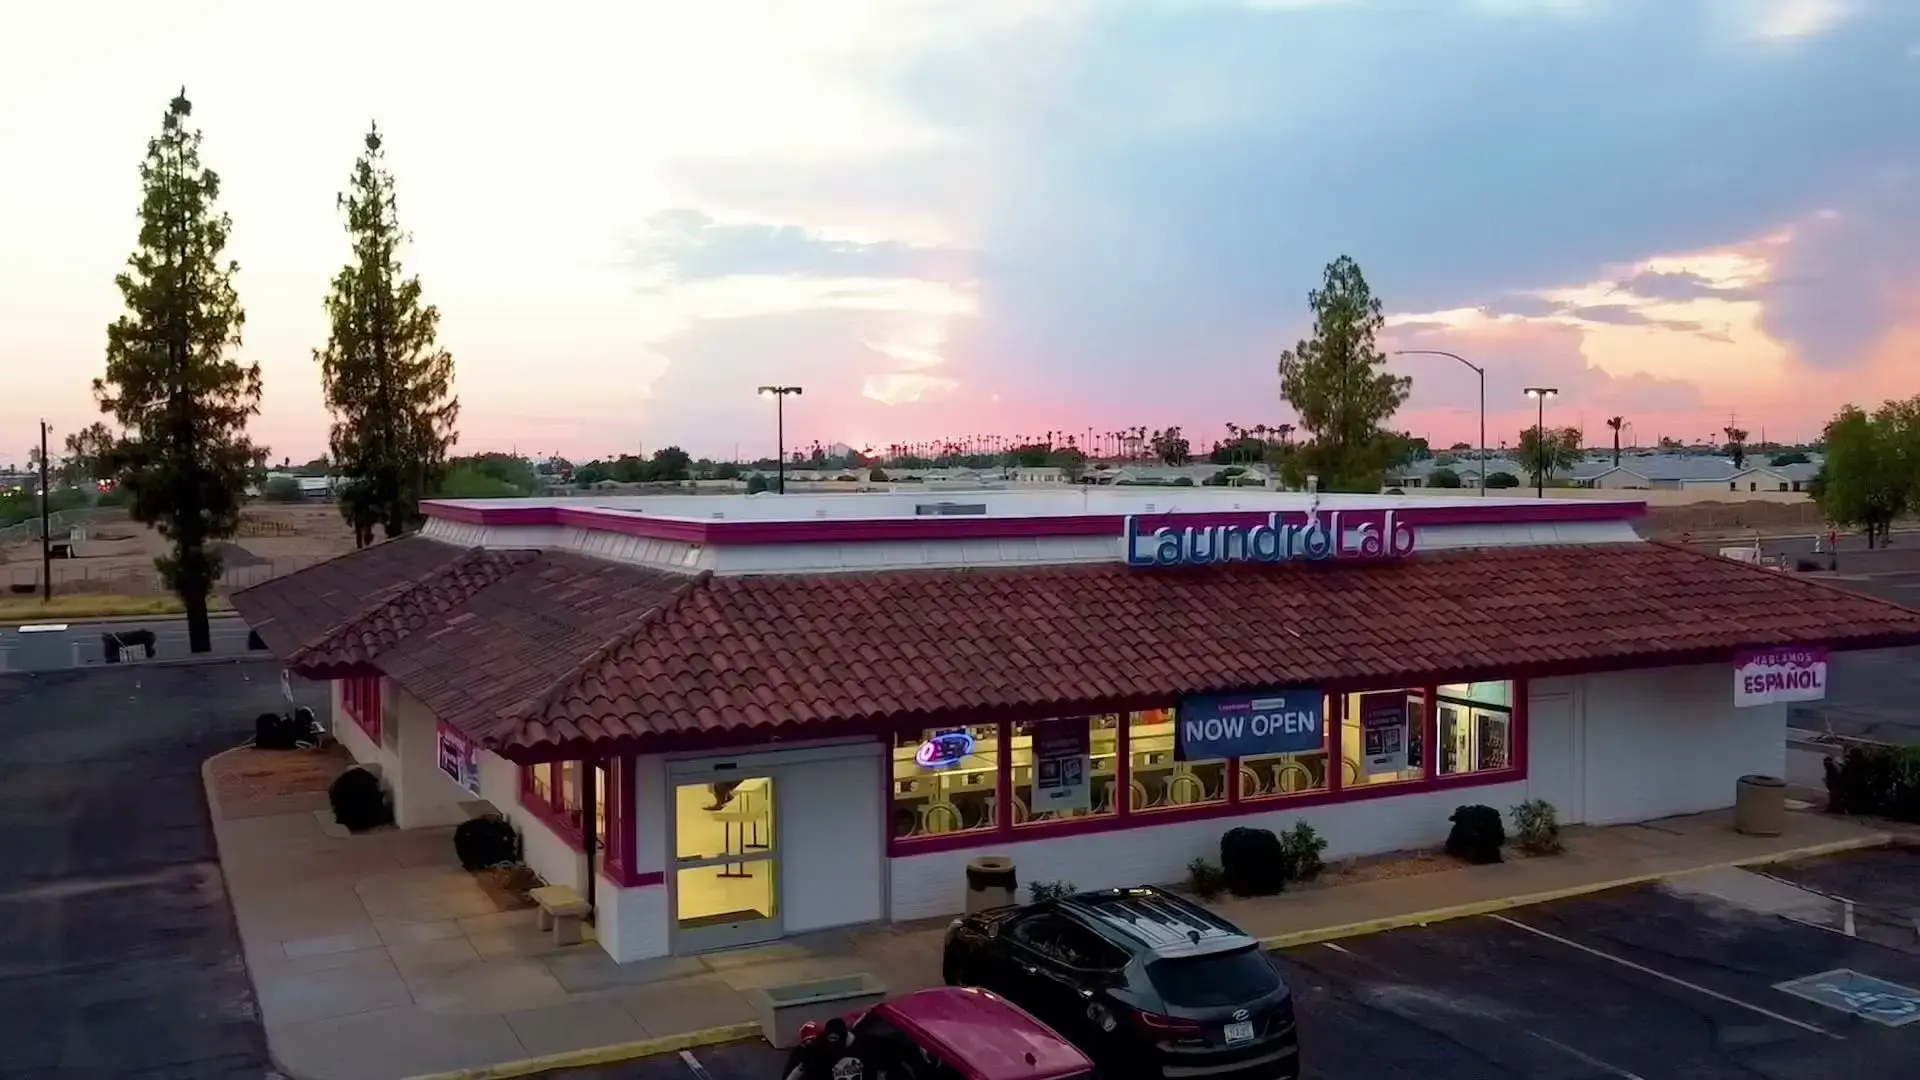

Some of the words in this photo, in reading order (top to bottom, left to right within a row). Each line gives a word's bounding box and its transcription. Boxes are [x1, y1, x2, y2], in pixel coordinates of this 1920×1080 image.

[1125, 510, 1416, 566] LaundroLab
[1753, 652, 1812, 665] HABLAMOS
[1744, 667, 1821, 694] ESPAÑOL
[1186, 717, 1245, 742] NOW
[1251, 711, 1315, 737] OPEN
